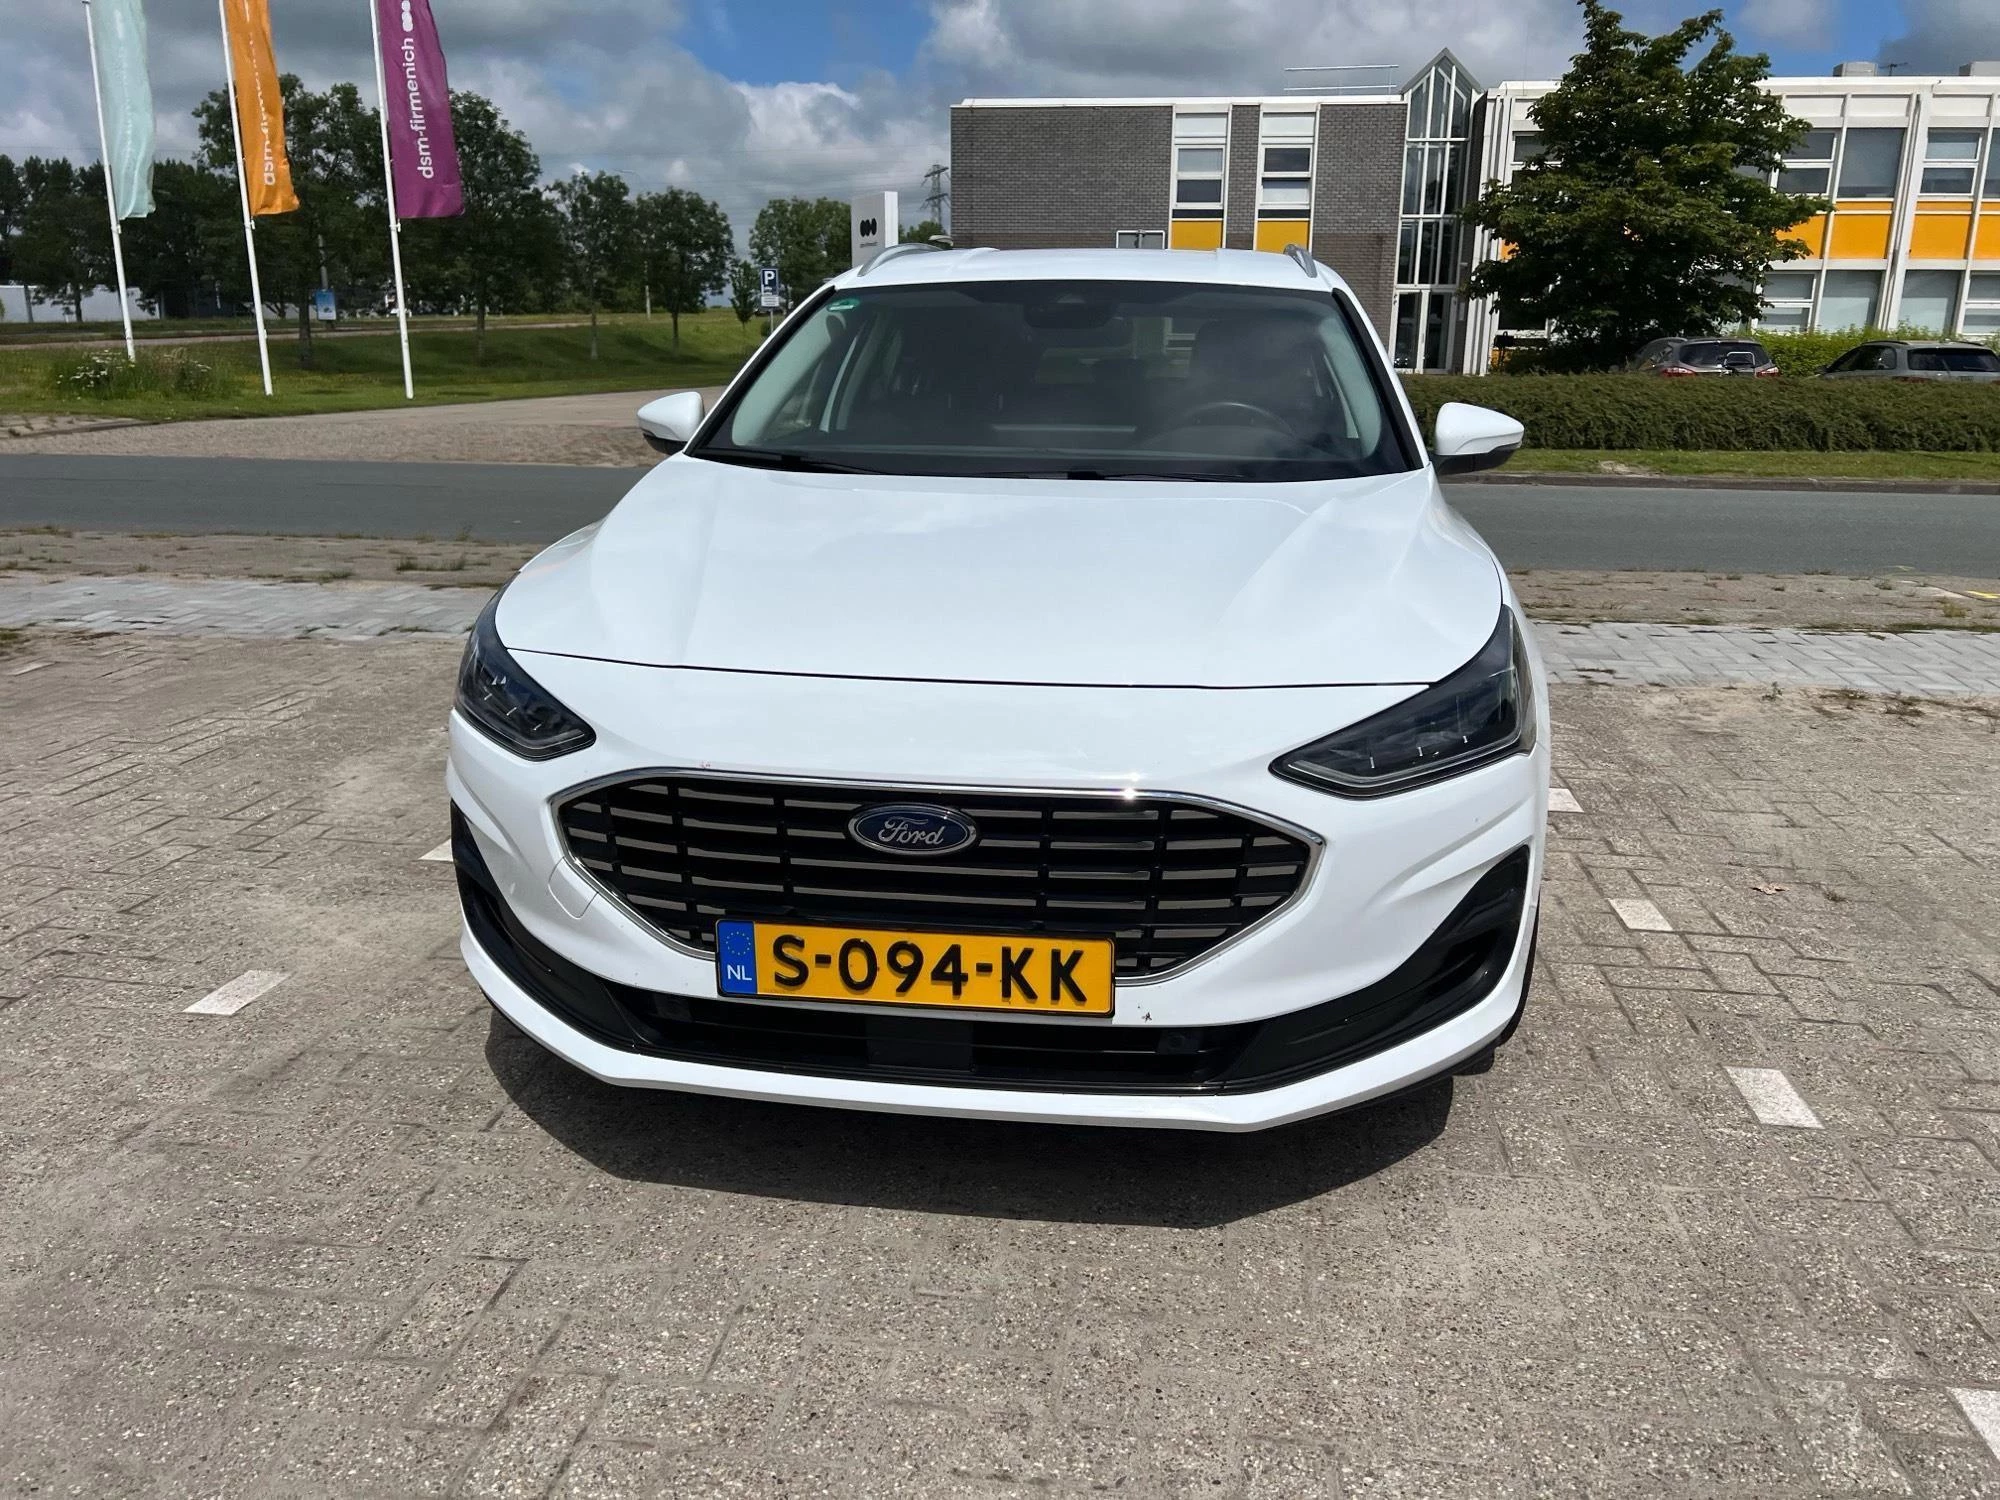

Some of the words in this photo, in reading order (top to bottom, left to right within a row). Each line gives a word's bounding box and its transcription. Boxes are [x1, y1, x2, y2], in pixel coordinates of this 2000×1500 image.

[401, 37, 434, 180] dsm-firmenich
[764, 270, 776, 285] P
[878, 815, 947, 845] Ford
[726, 964, 753, 981] NL
[772, 933, 1088, 1003] S-094-KK
